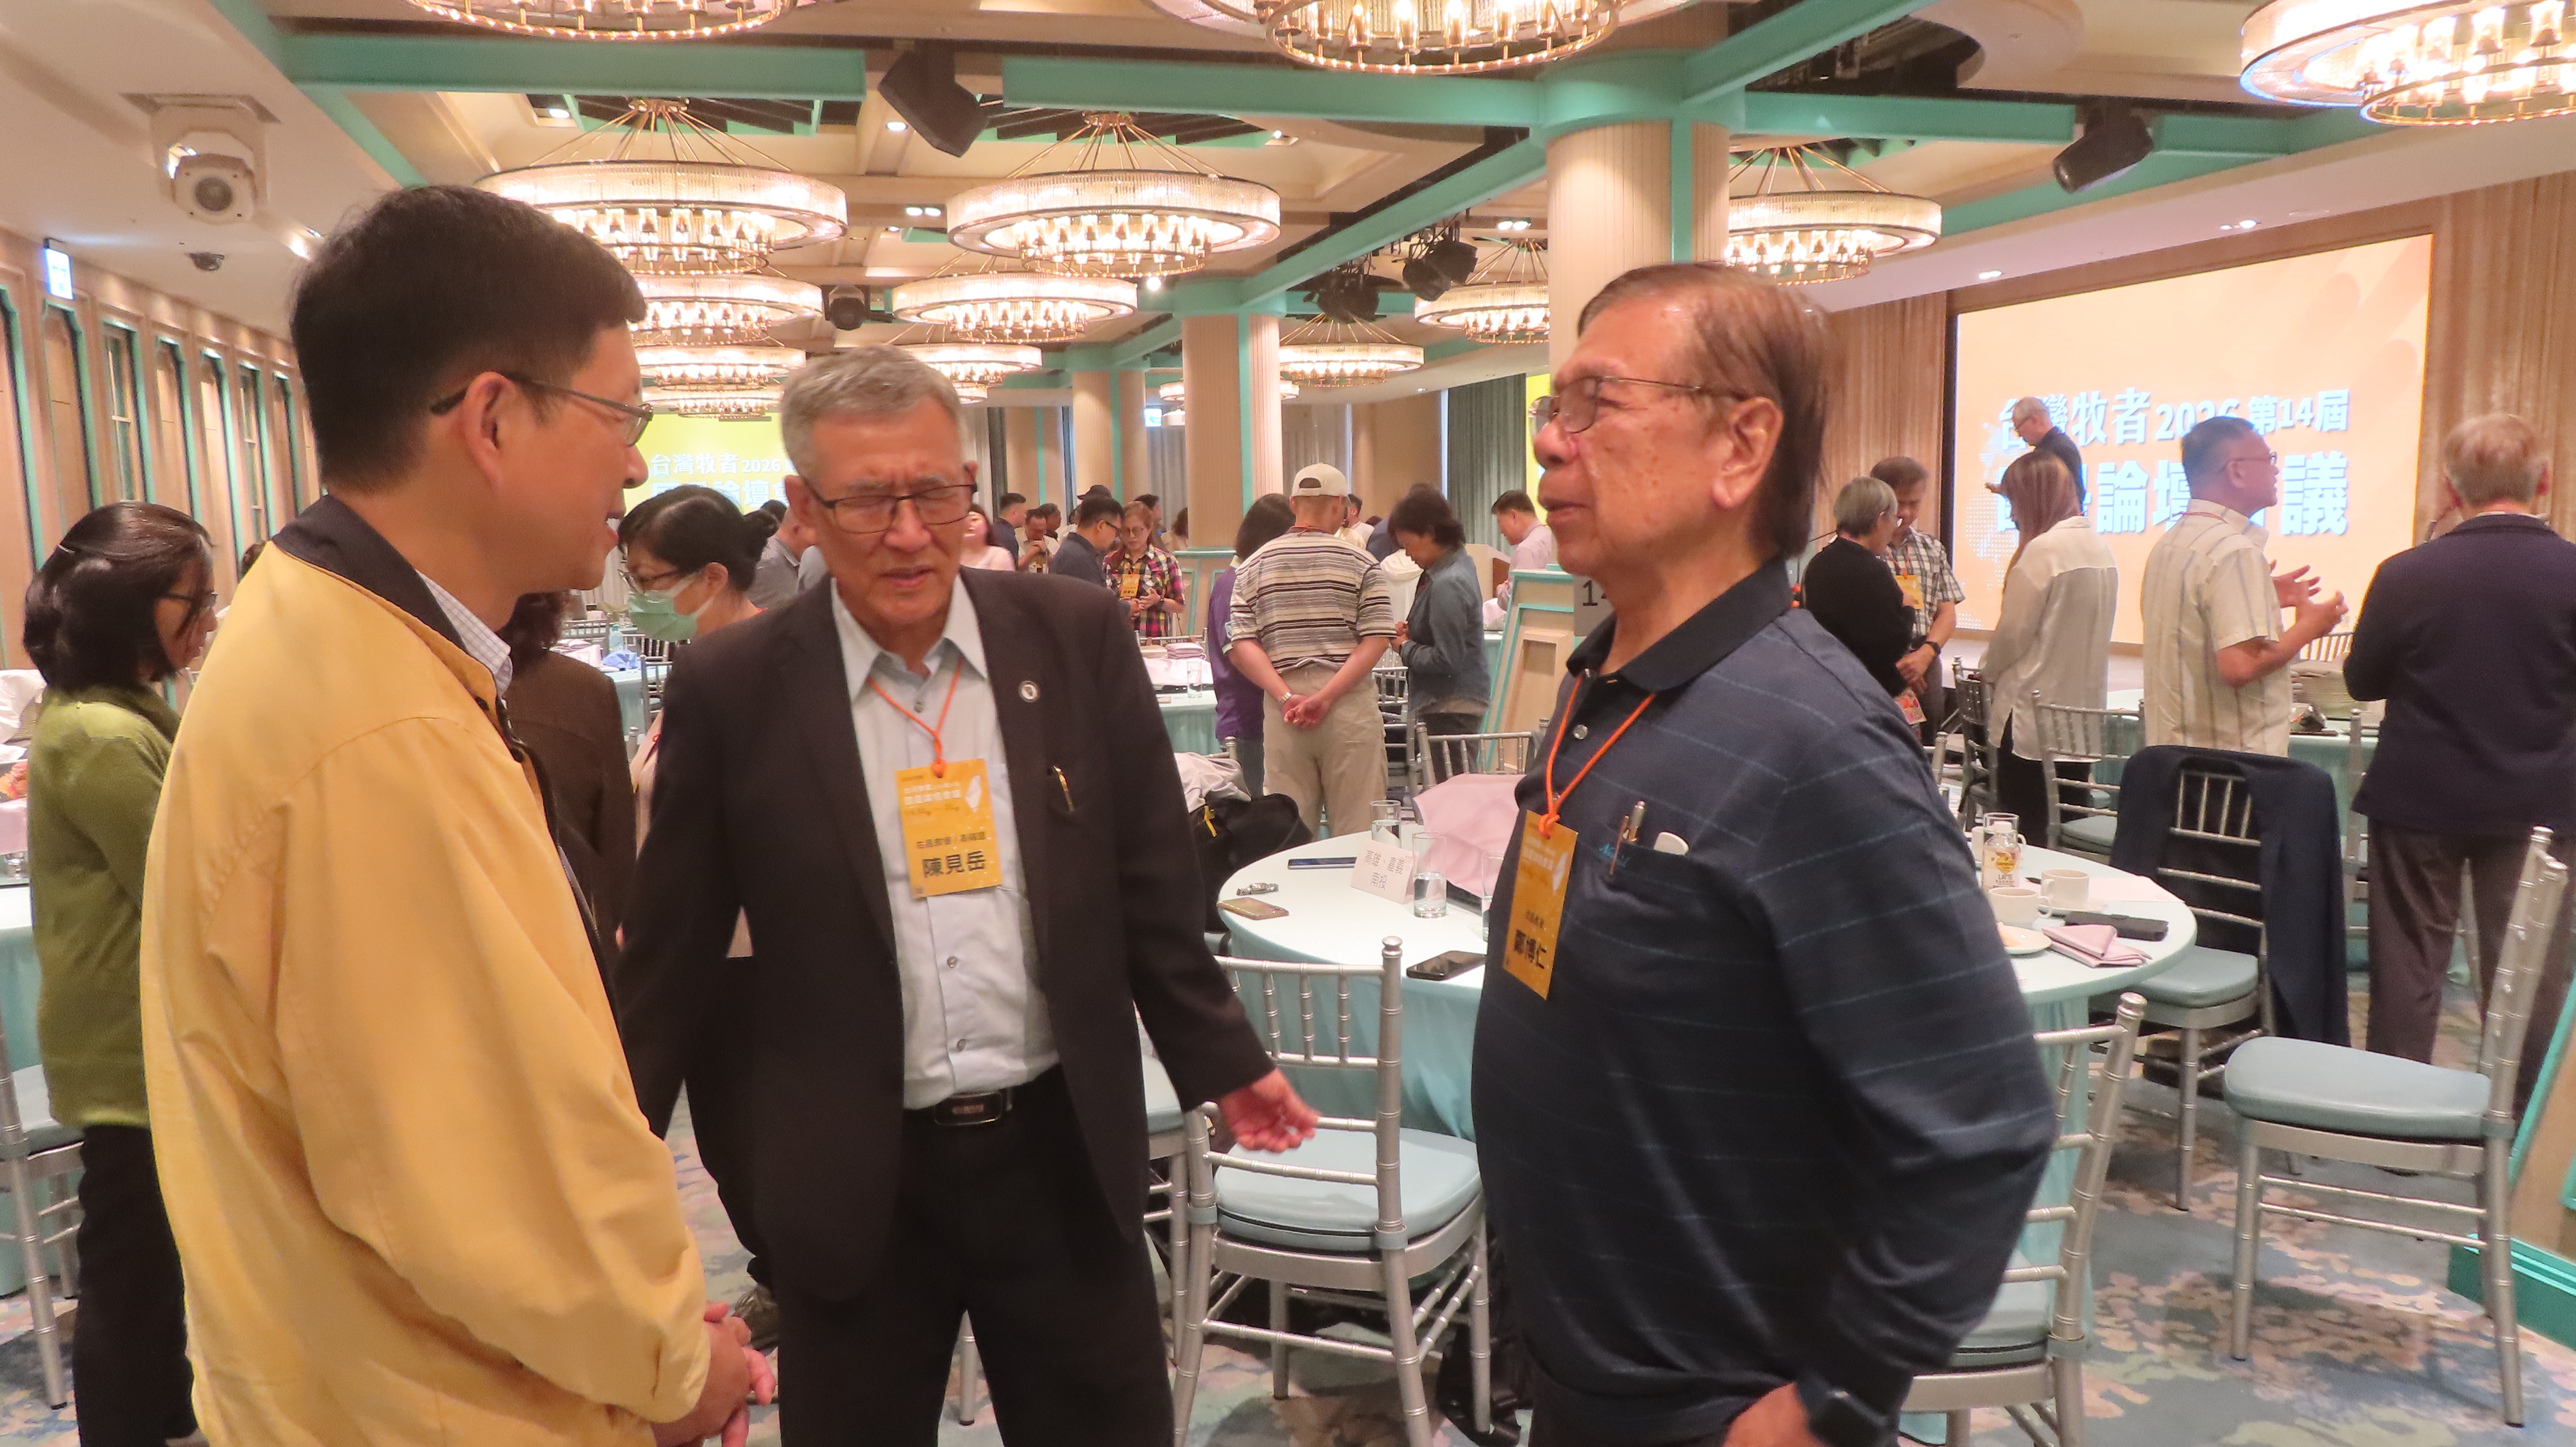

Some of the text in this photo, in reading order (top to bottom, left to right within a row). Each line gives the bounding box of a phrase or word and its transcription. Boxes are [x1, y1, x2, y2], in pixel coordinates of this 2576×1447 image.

[650, 452, 738, 476] 台灣牧者
[741, 458, 781, 473] 2026
[1370, 872, 1388, 890] 南投
